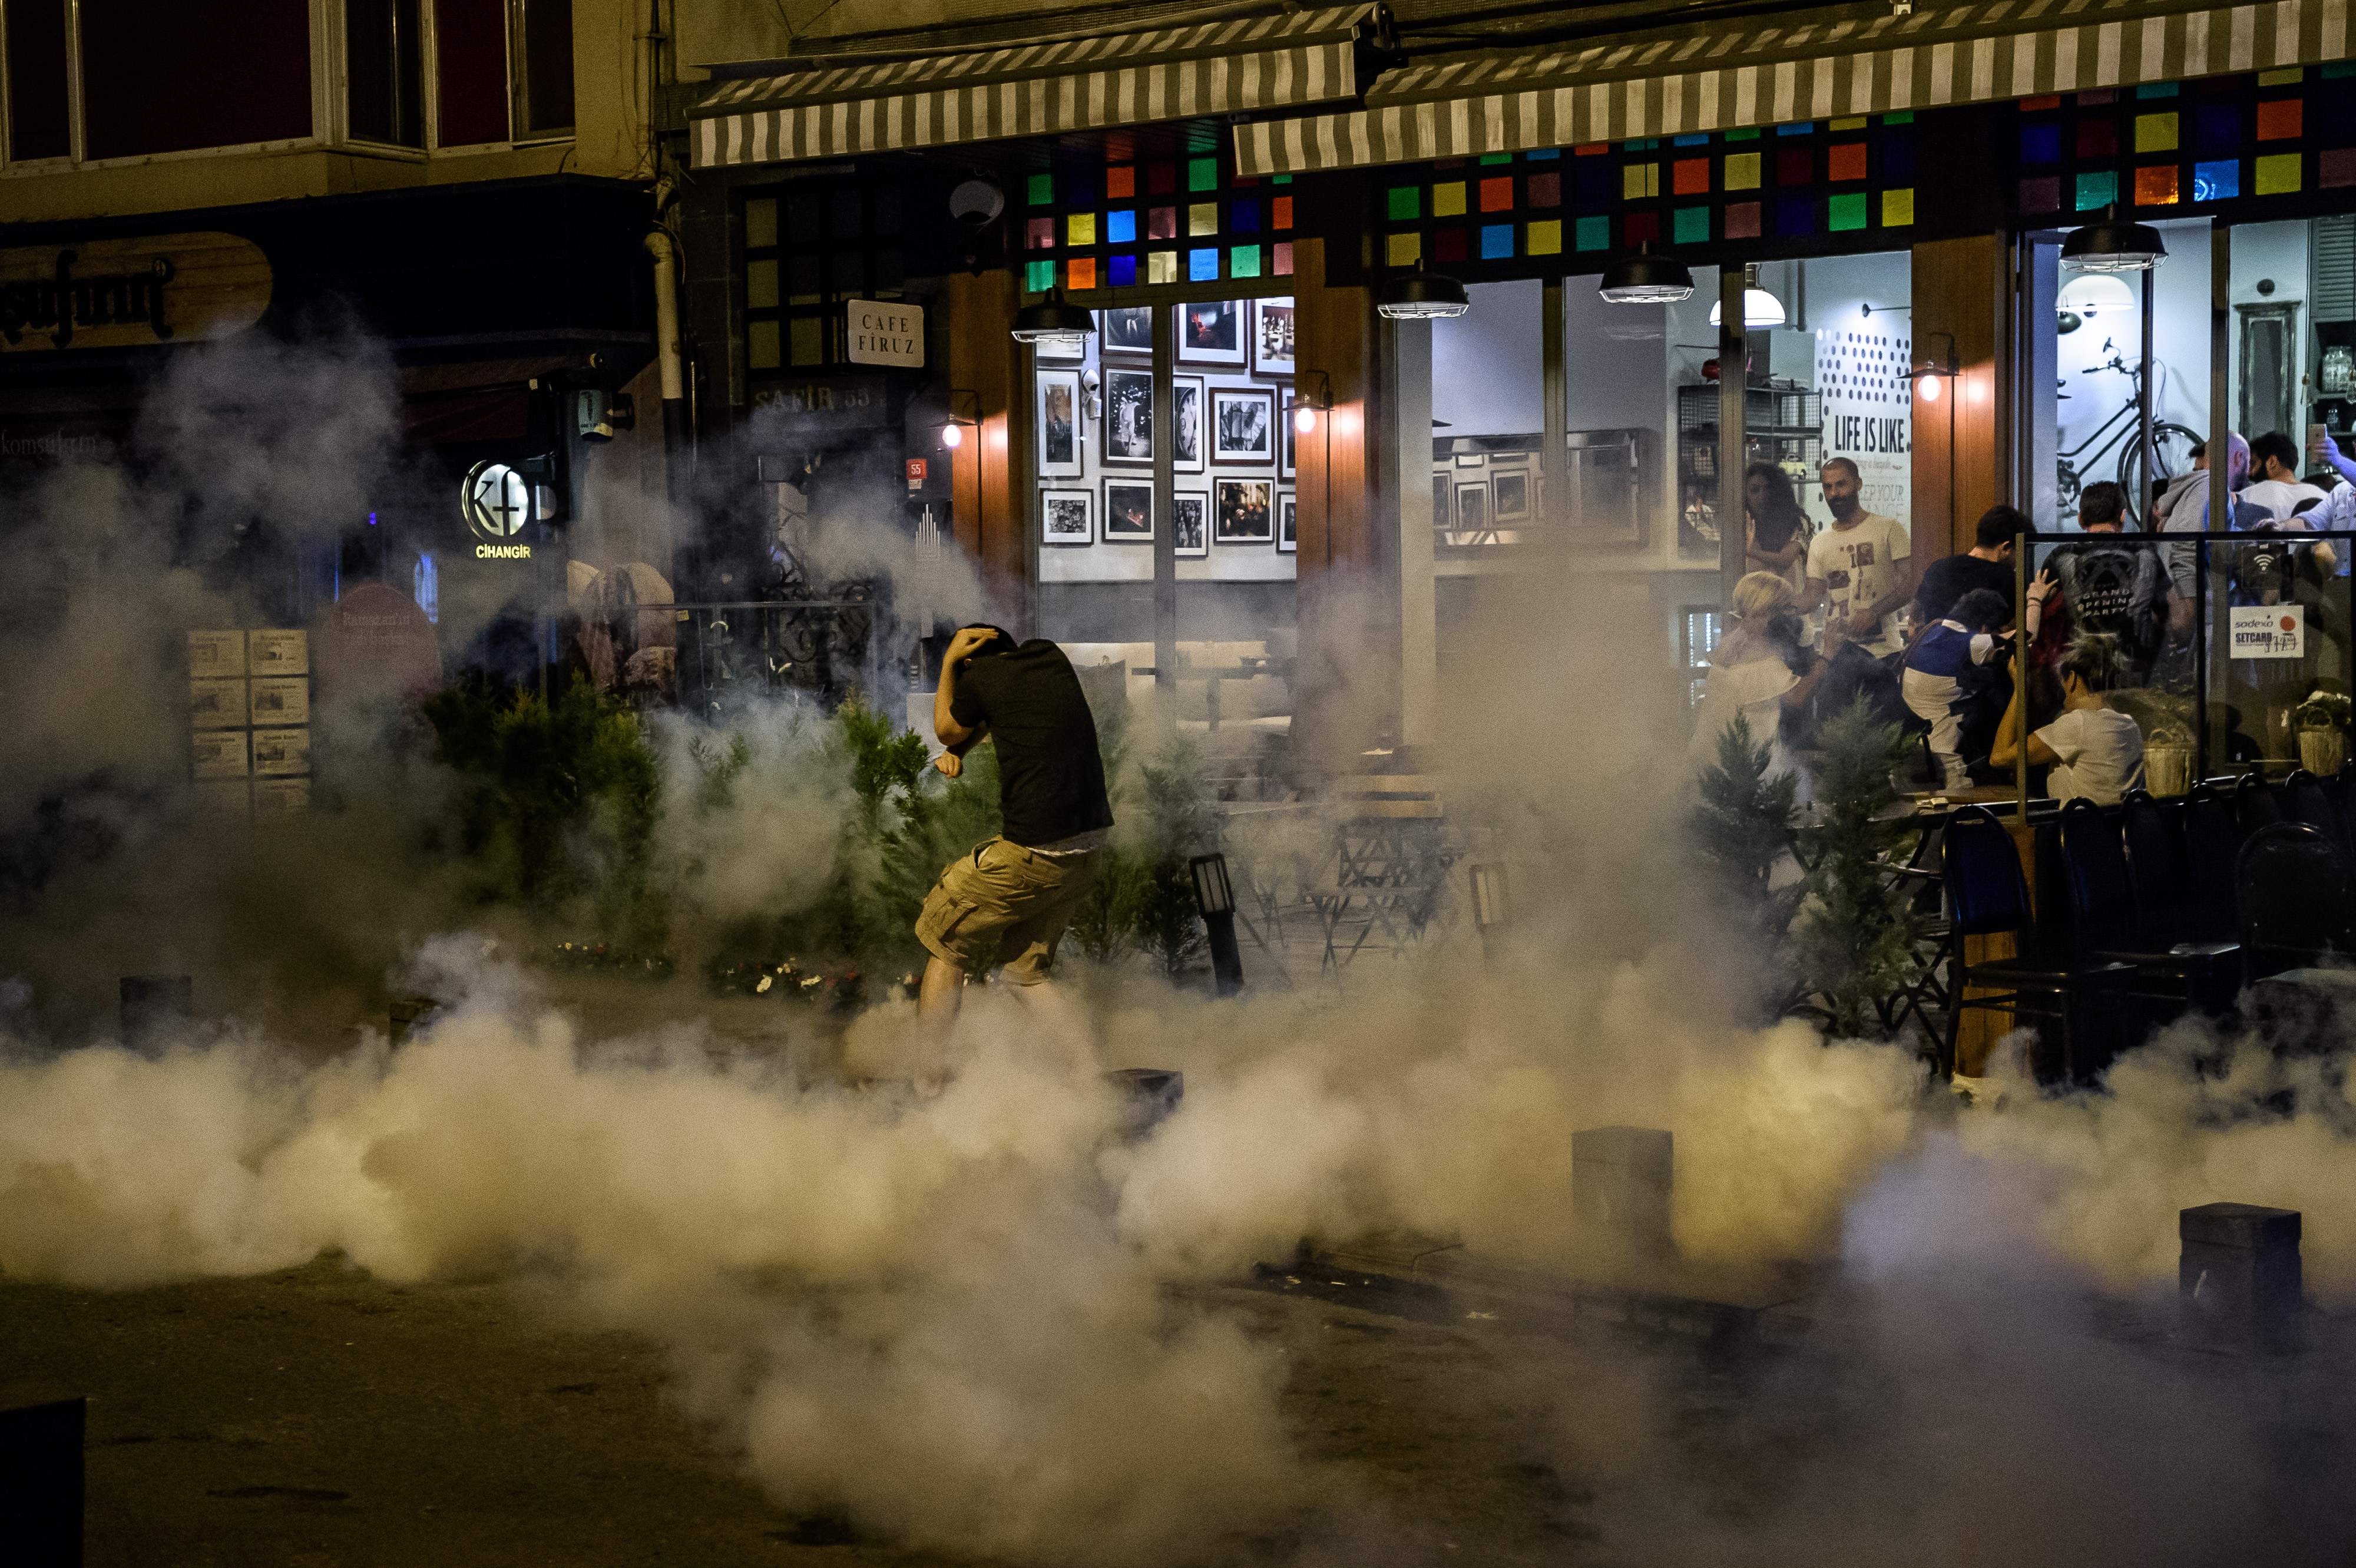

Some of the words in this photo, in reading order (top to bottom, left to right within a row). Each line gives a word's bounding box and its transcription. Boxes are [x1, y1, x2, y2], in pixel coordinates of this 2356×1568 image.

[862, 314, 908, 332] CAFE
[1835, 415, 1860, 451] LIFE
[1865, 417, 1875, 452] IS
[1879, 418, 1904, 453] LIKE
[911, 464, 921, 475] 55
[1877, 484, 1904, 502] YOUR
[476, 544, 531, 558] CİHANGİR
[2235, 632, 2272, 643] SETCARD
